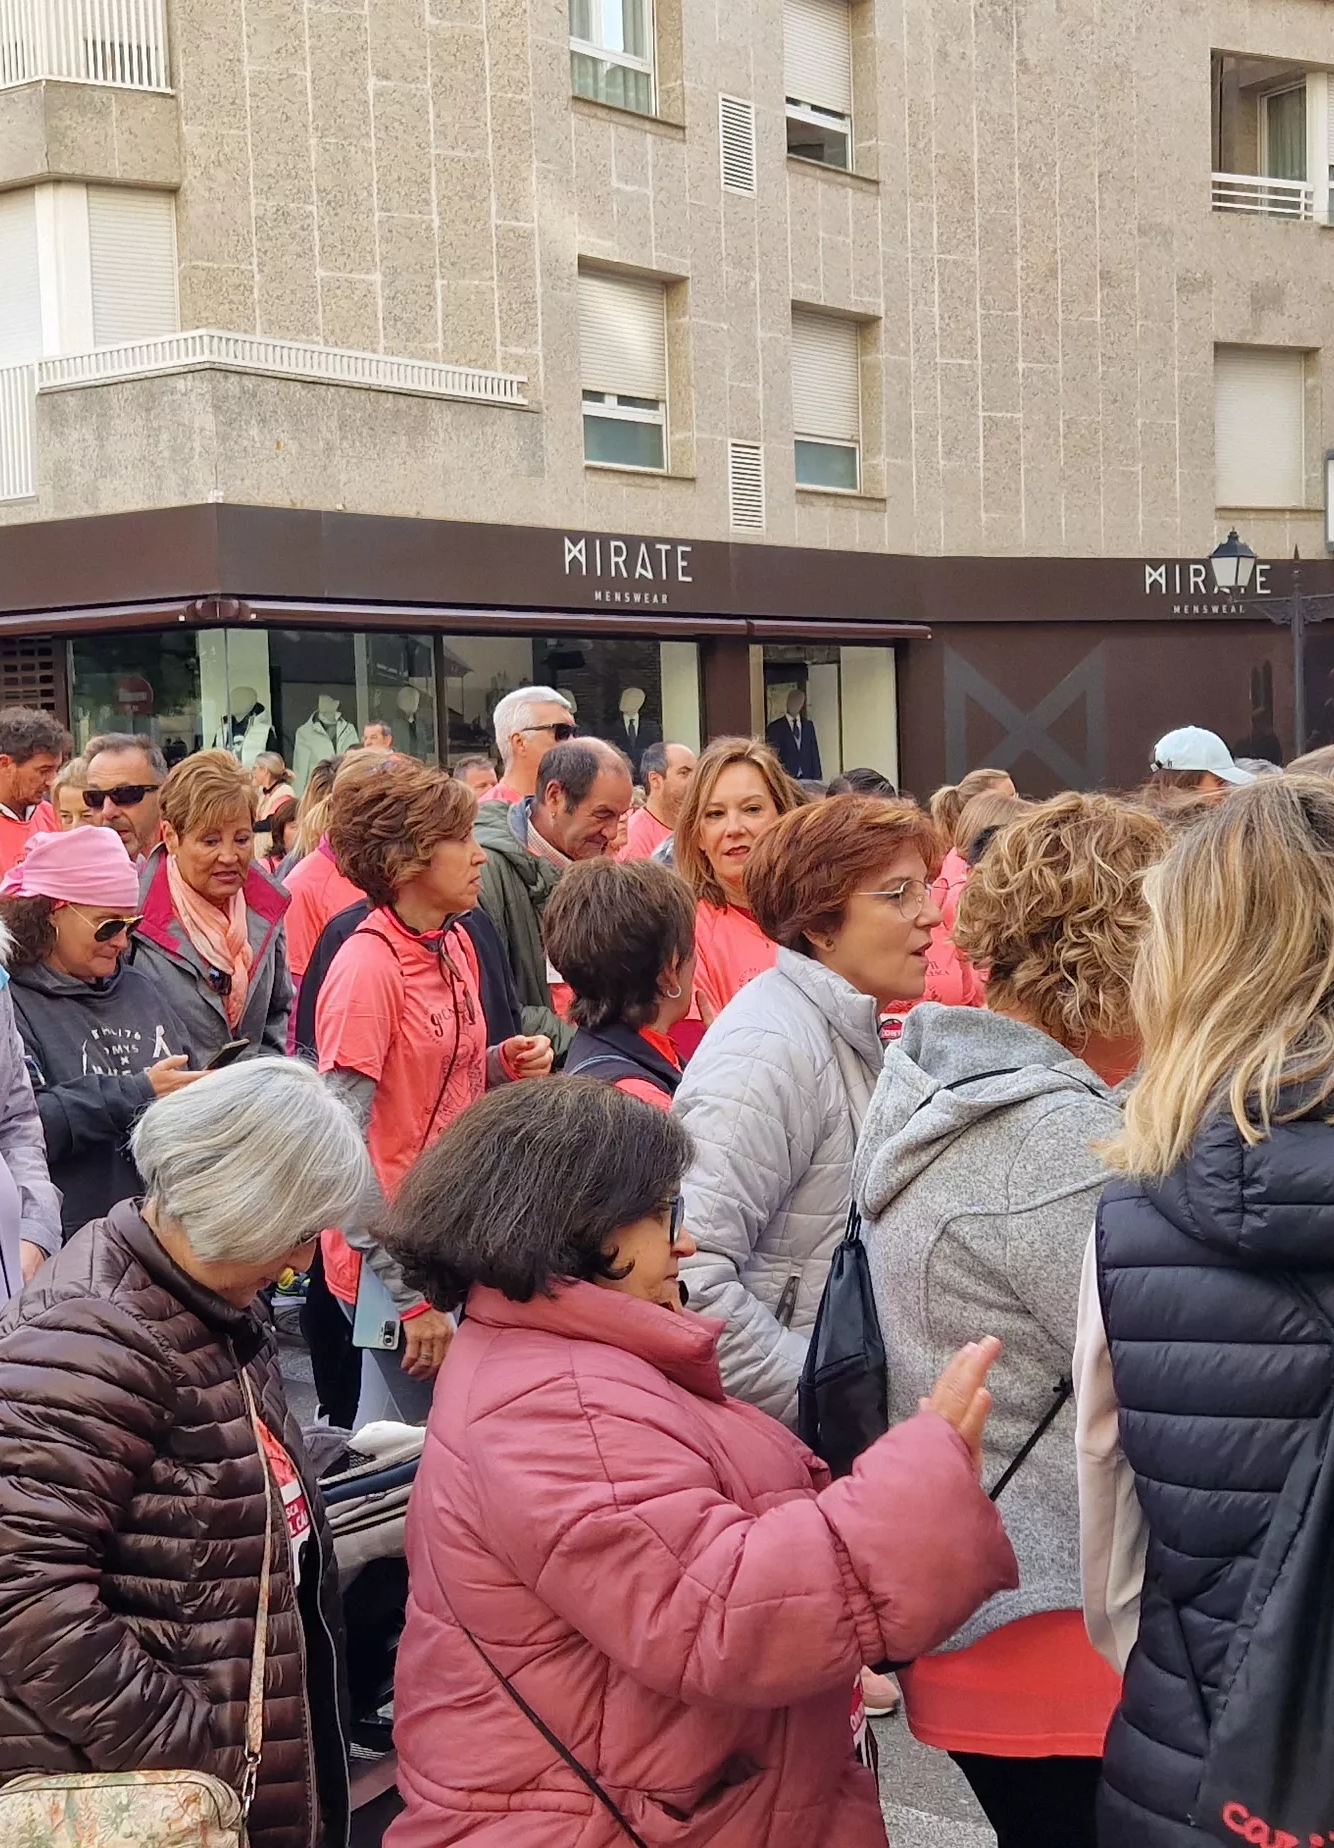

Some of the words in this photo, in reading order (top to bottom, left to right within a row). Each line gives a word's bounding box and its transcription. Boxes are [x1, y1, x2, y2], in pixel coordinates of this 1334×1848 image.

[563, 536, 693, 583] MIRATE
[1145, 564, 1271, 594] MIRE
[594, 590, 668, 604] MENSWEAR
